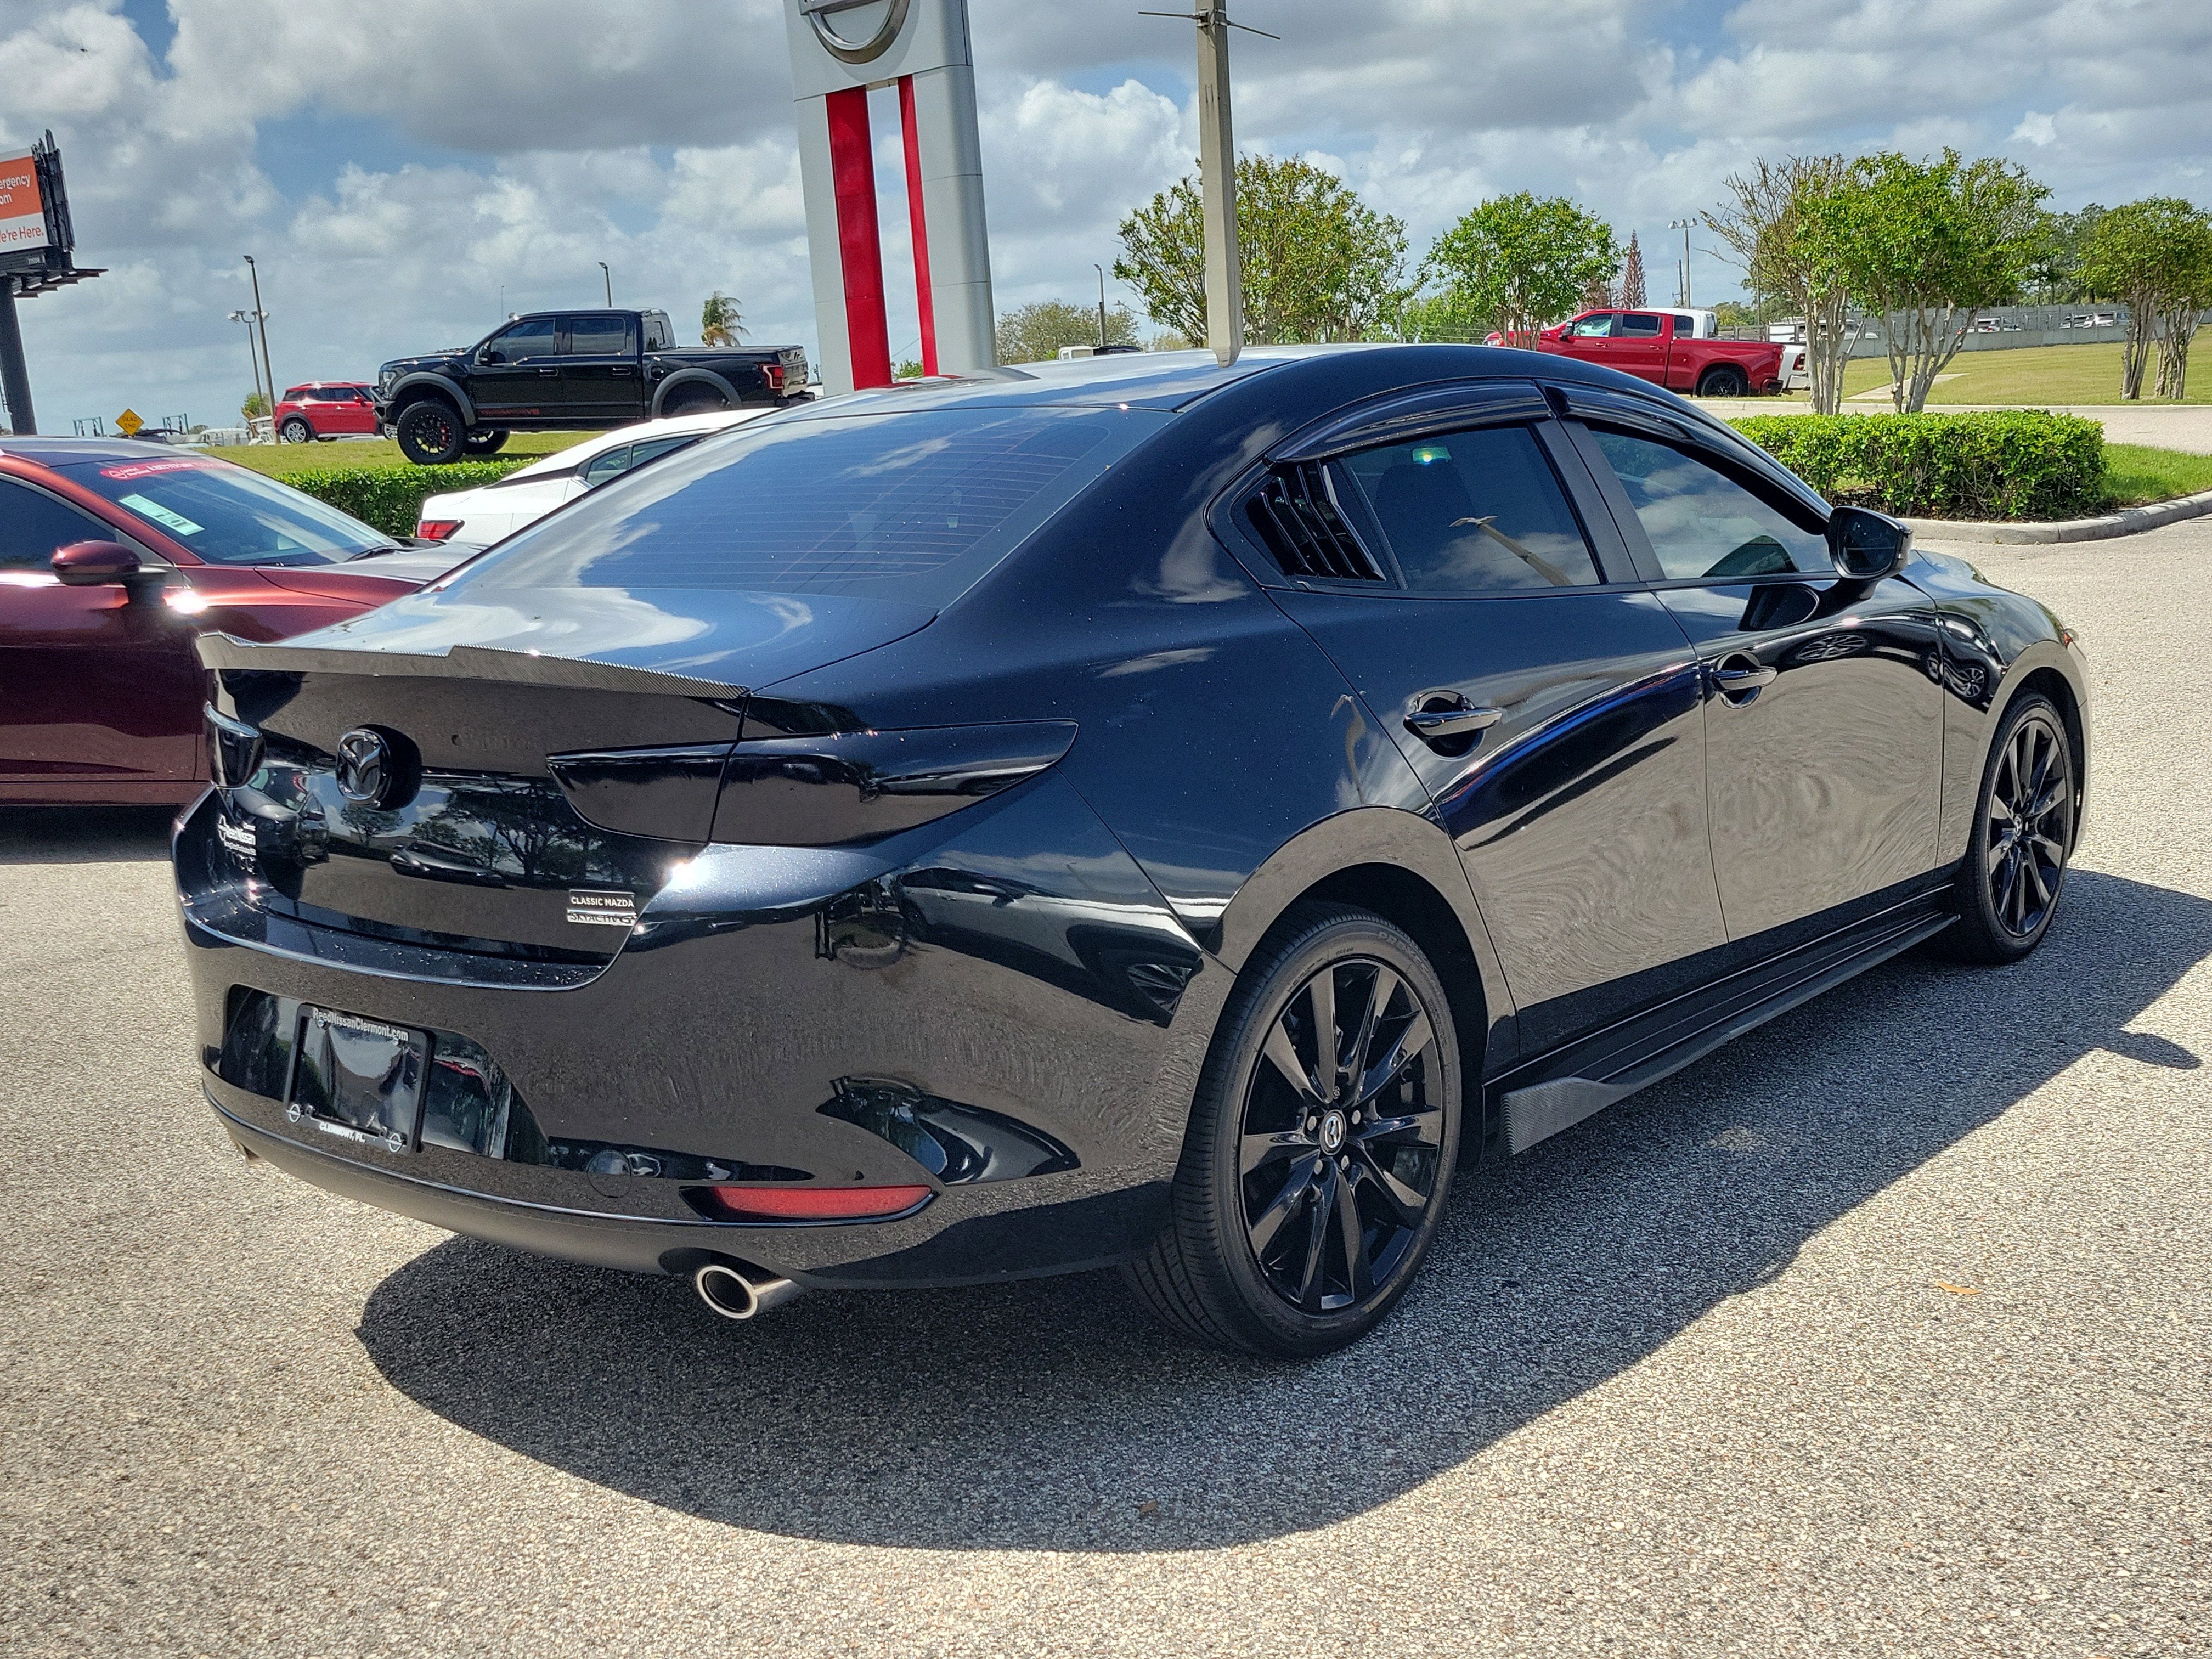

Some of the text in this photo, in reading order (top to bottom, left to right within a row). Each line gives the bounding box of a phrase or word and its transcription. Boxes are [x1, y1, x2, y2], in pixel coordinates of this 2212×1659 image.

[19, 226, 44, 239] Here.
[571, 896, 635, 908] CLASSIC MAZDA
[313, 1007, 409, 1042] ReedNissanClermont.com
